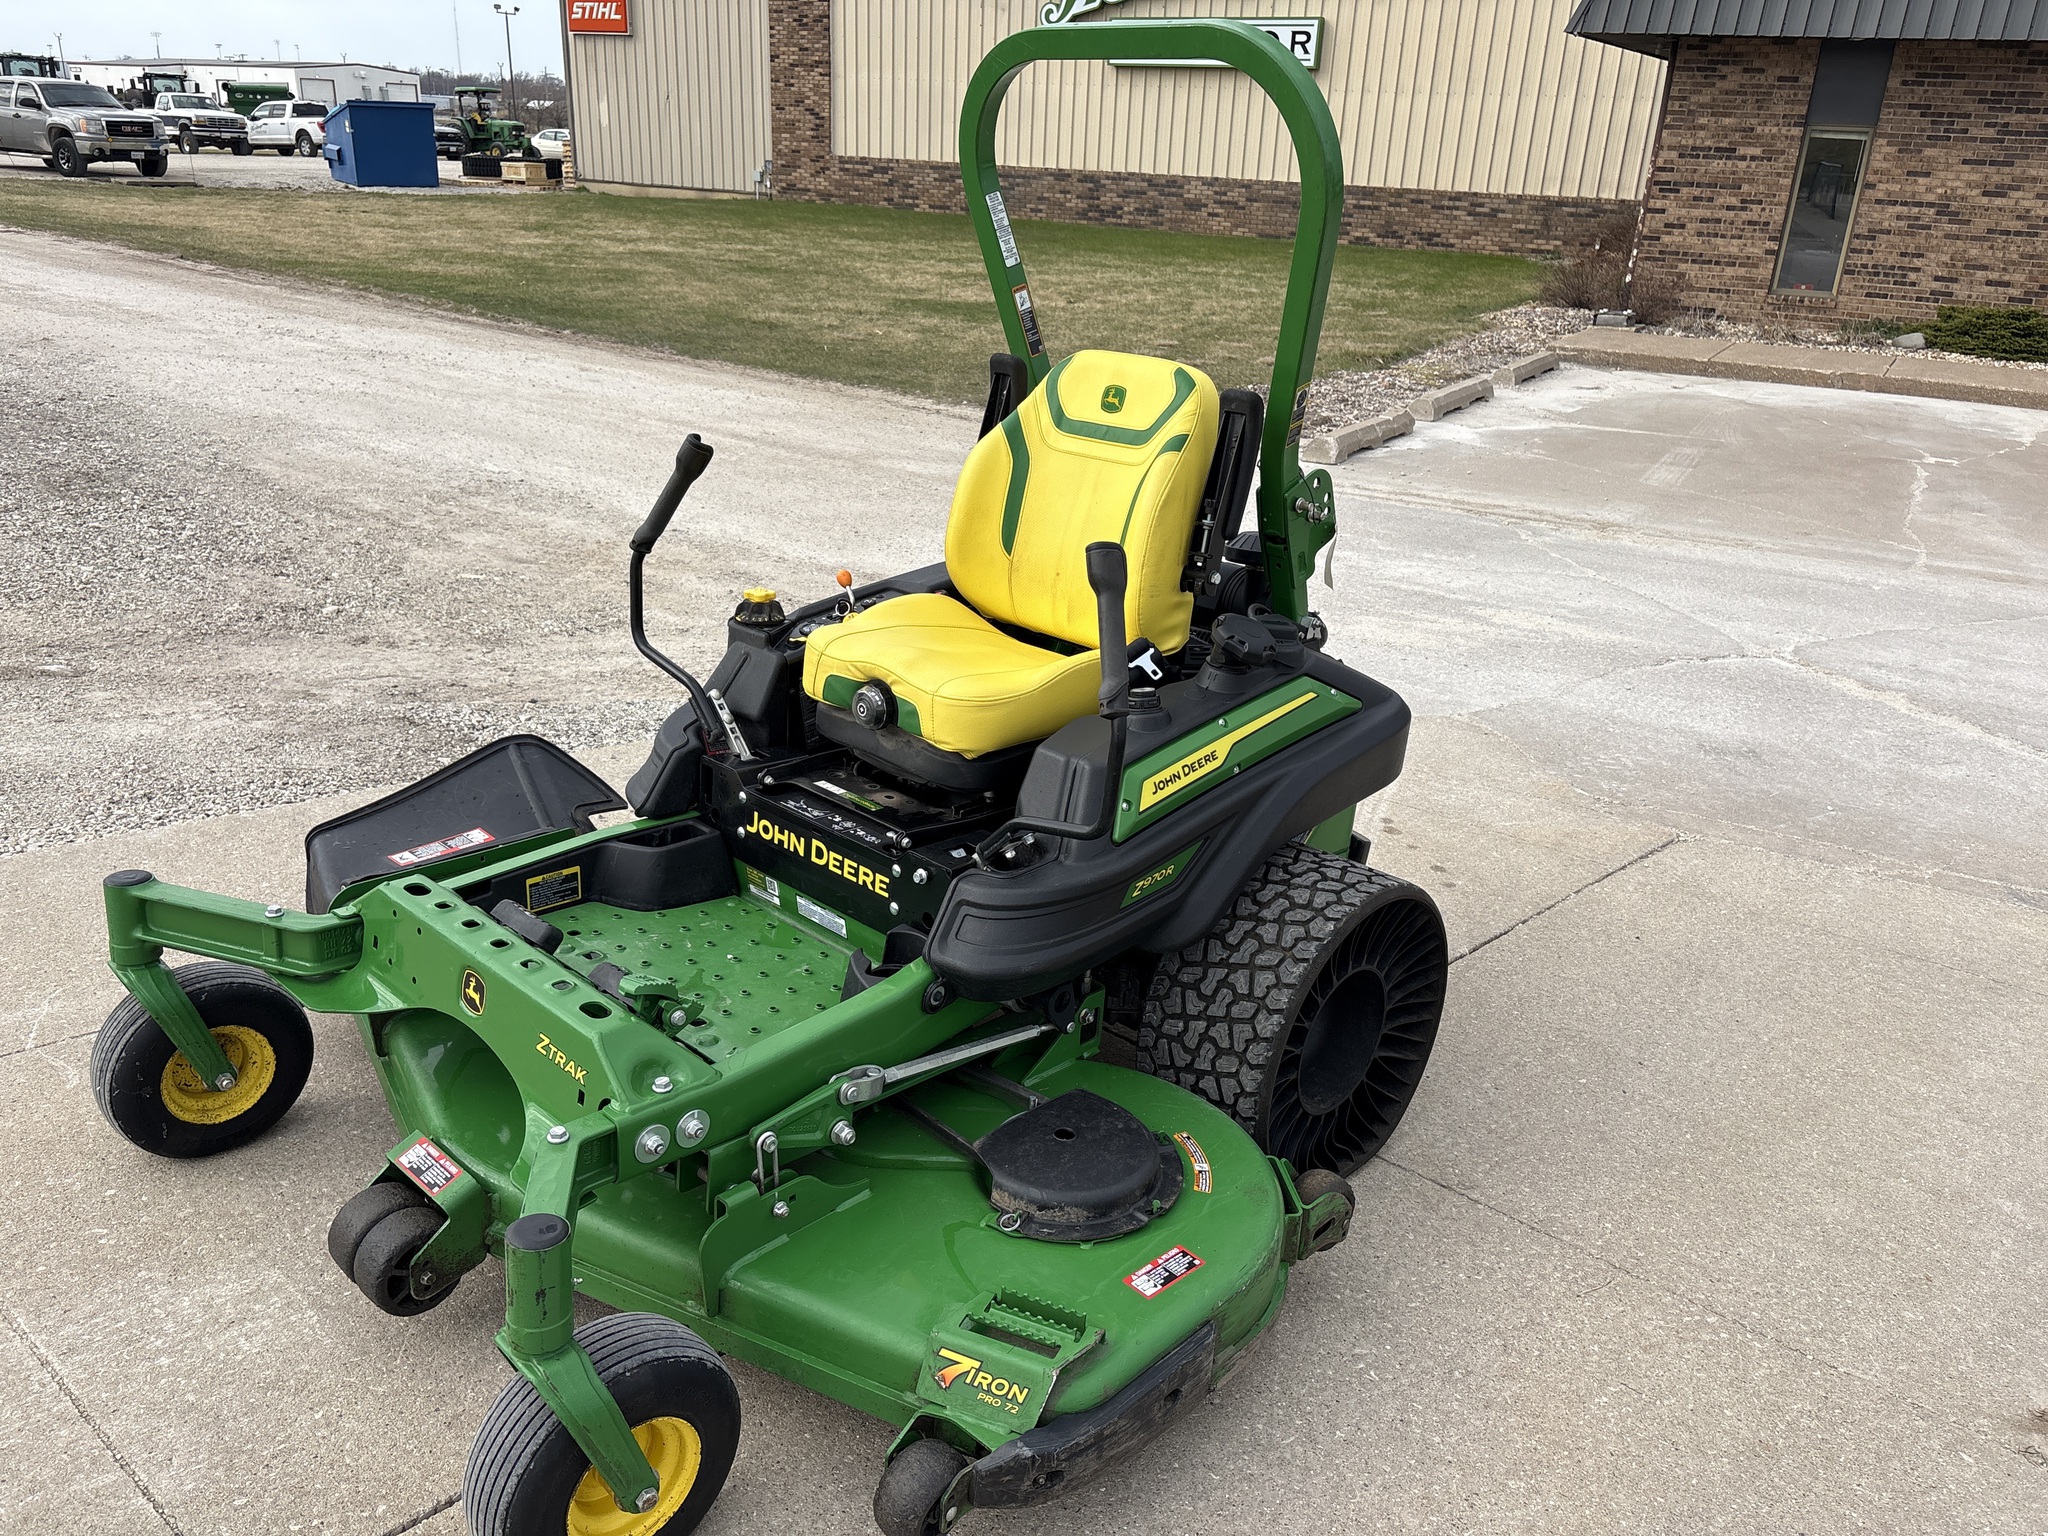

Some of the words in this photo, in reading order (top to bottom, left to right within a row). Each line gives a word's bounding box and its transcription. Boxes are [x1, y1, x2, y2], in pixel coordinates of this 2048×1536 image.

[571, 2, 622, 20] STIHL
[1152, 771, 1182, 796] JOHN
[1181, 749, 1219, 778] DEERE
[746, 811, 805, 857] JOHN
[811, 838, 890, 898] DEERE
[1131, 864, 1175, 898] Z970R
[976, 1392, 1002, 1407] PRO
[1003, 1402, 1020, 1415] 72
